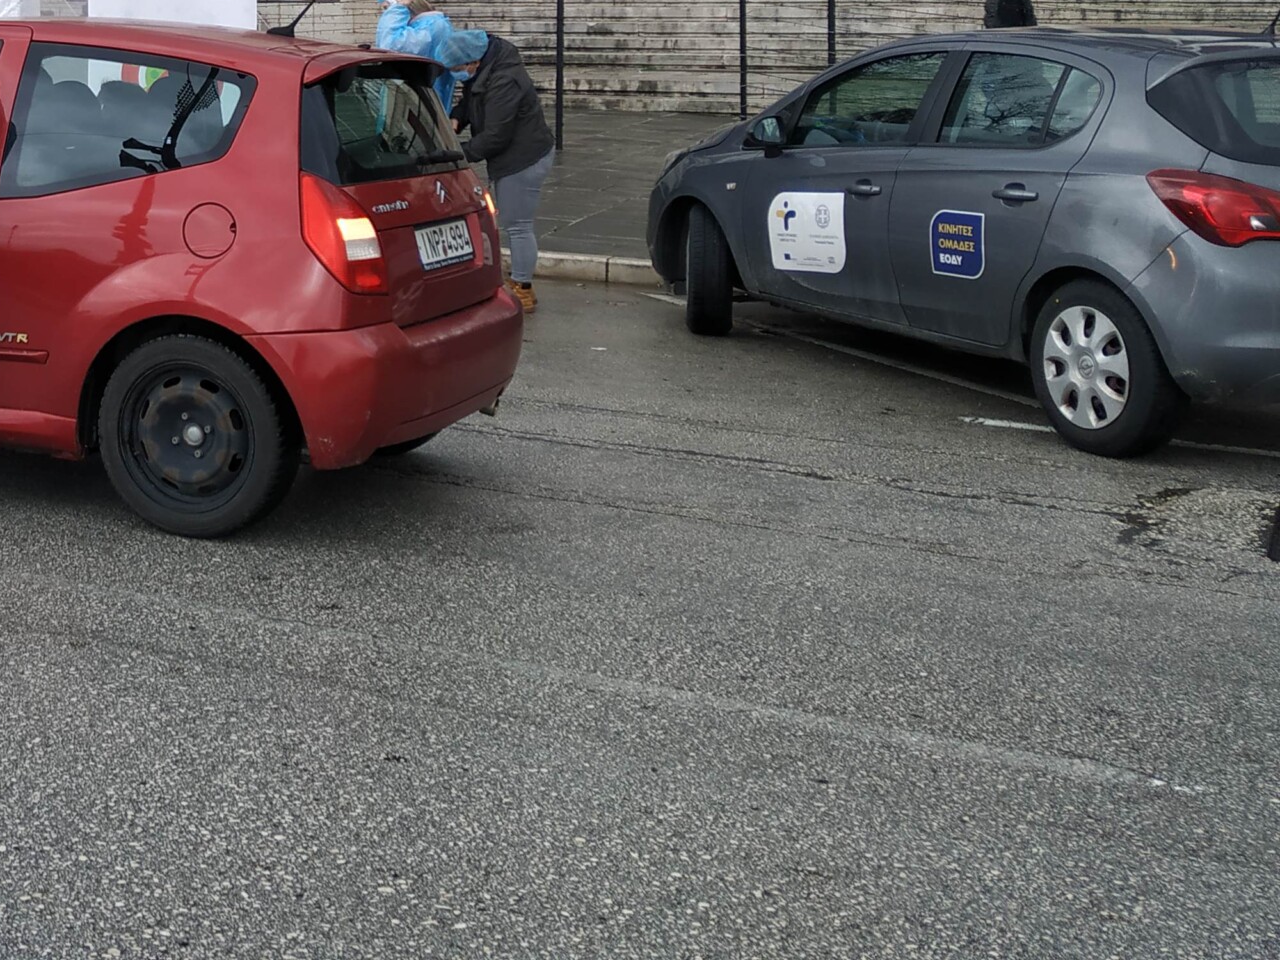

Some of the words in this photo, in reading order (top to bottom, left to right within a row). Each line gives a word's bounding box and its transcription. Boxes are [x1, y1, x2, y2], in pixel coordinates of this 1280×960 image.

[938, 223, 973, 237] ΚΙΝΗΤΕΣ
[938, 238, 975, 252] ΟΜΑΔΕΣ
[939, 253, 962, 265] ΕΟΔΥ
